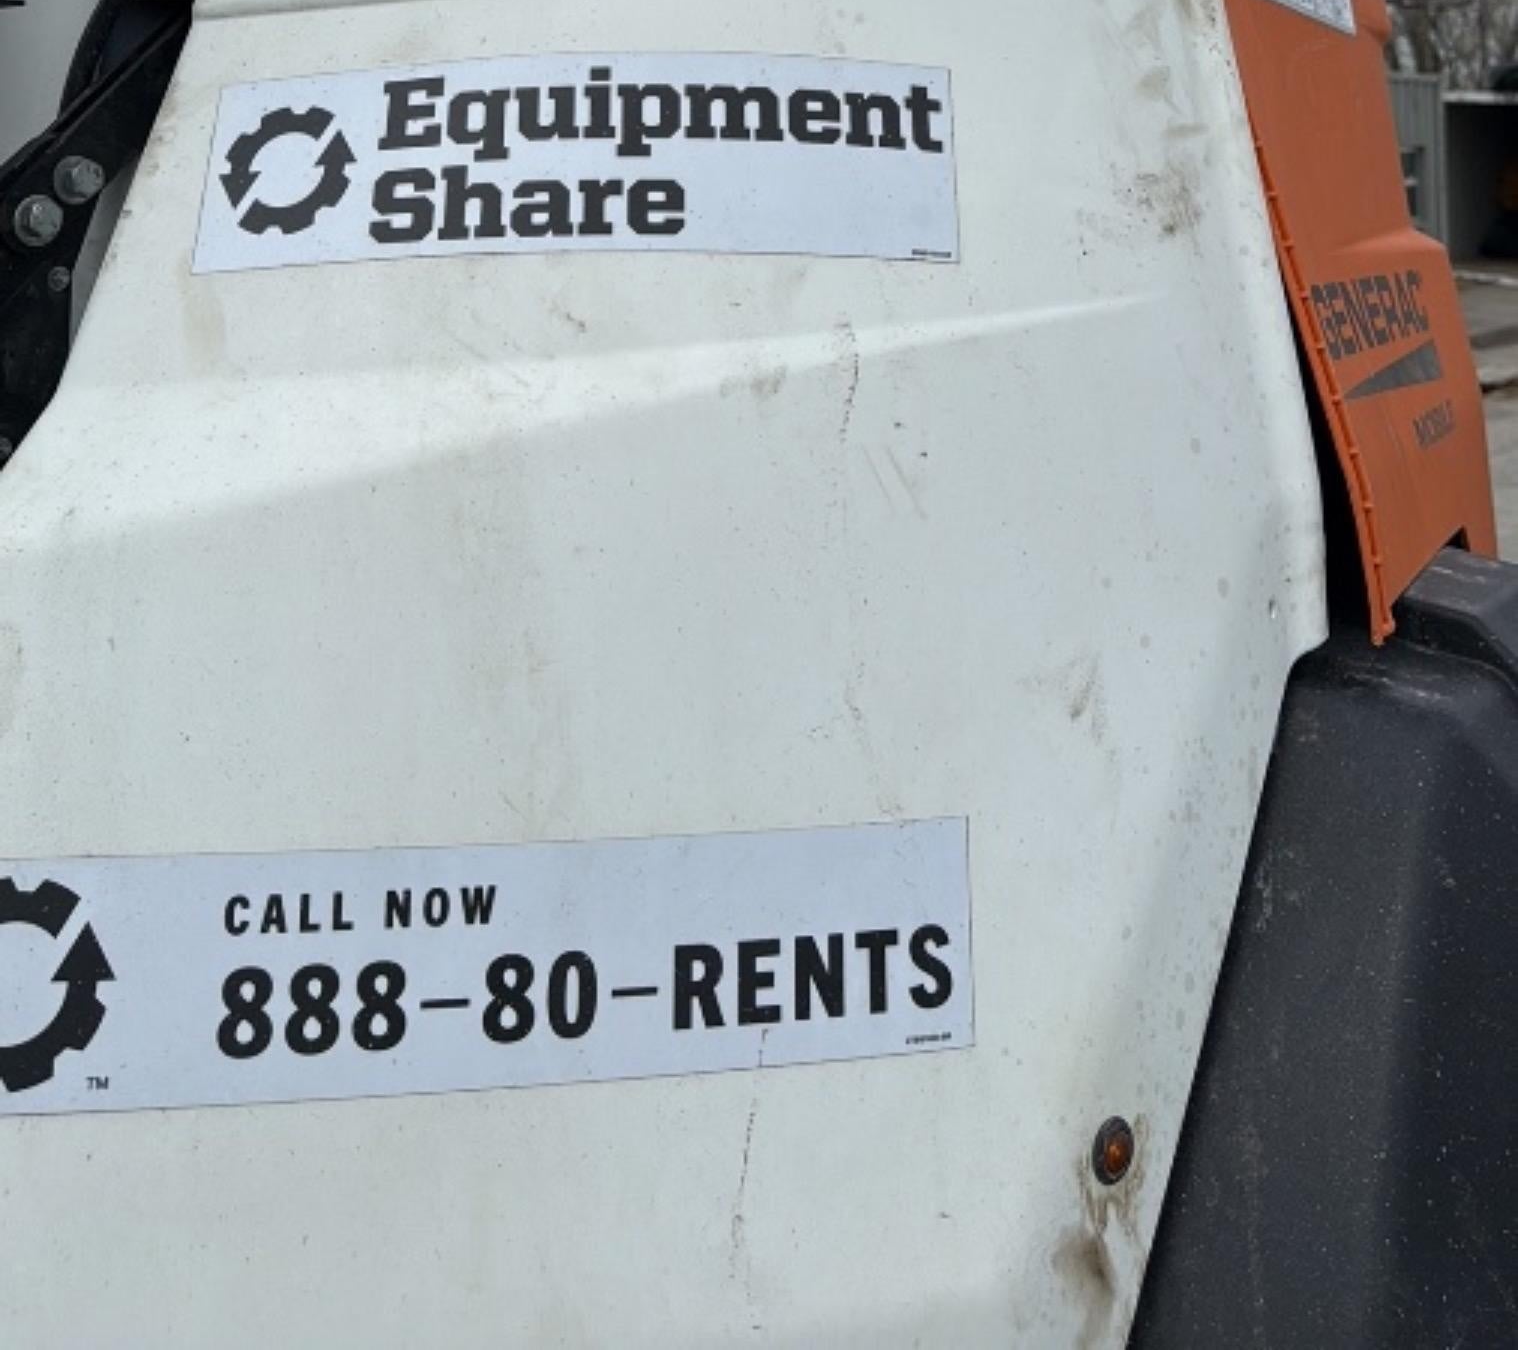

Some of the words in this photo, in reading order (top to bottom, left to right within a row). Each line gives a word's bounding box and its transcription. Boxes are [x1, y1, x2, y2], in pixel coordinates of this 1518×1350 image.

[377, 66, 944, 161] Equipment
[368, 165, 686, 244] Share
[1310, 269, 1430, 361] GENERAC
[224, 892, 355, 937] CALL
[383, 884, 497, 929] NOW
[215, 923, 954, 1061] 888-80-RENTS
